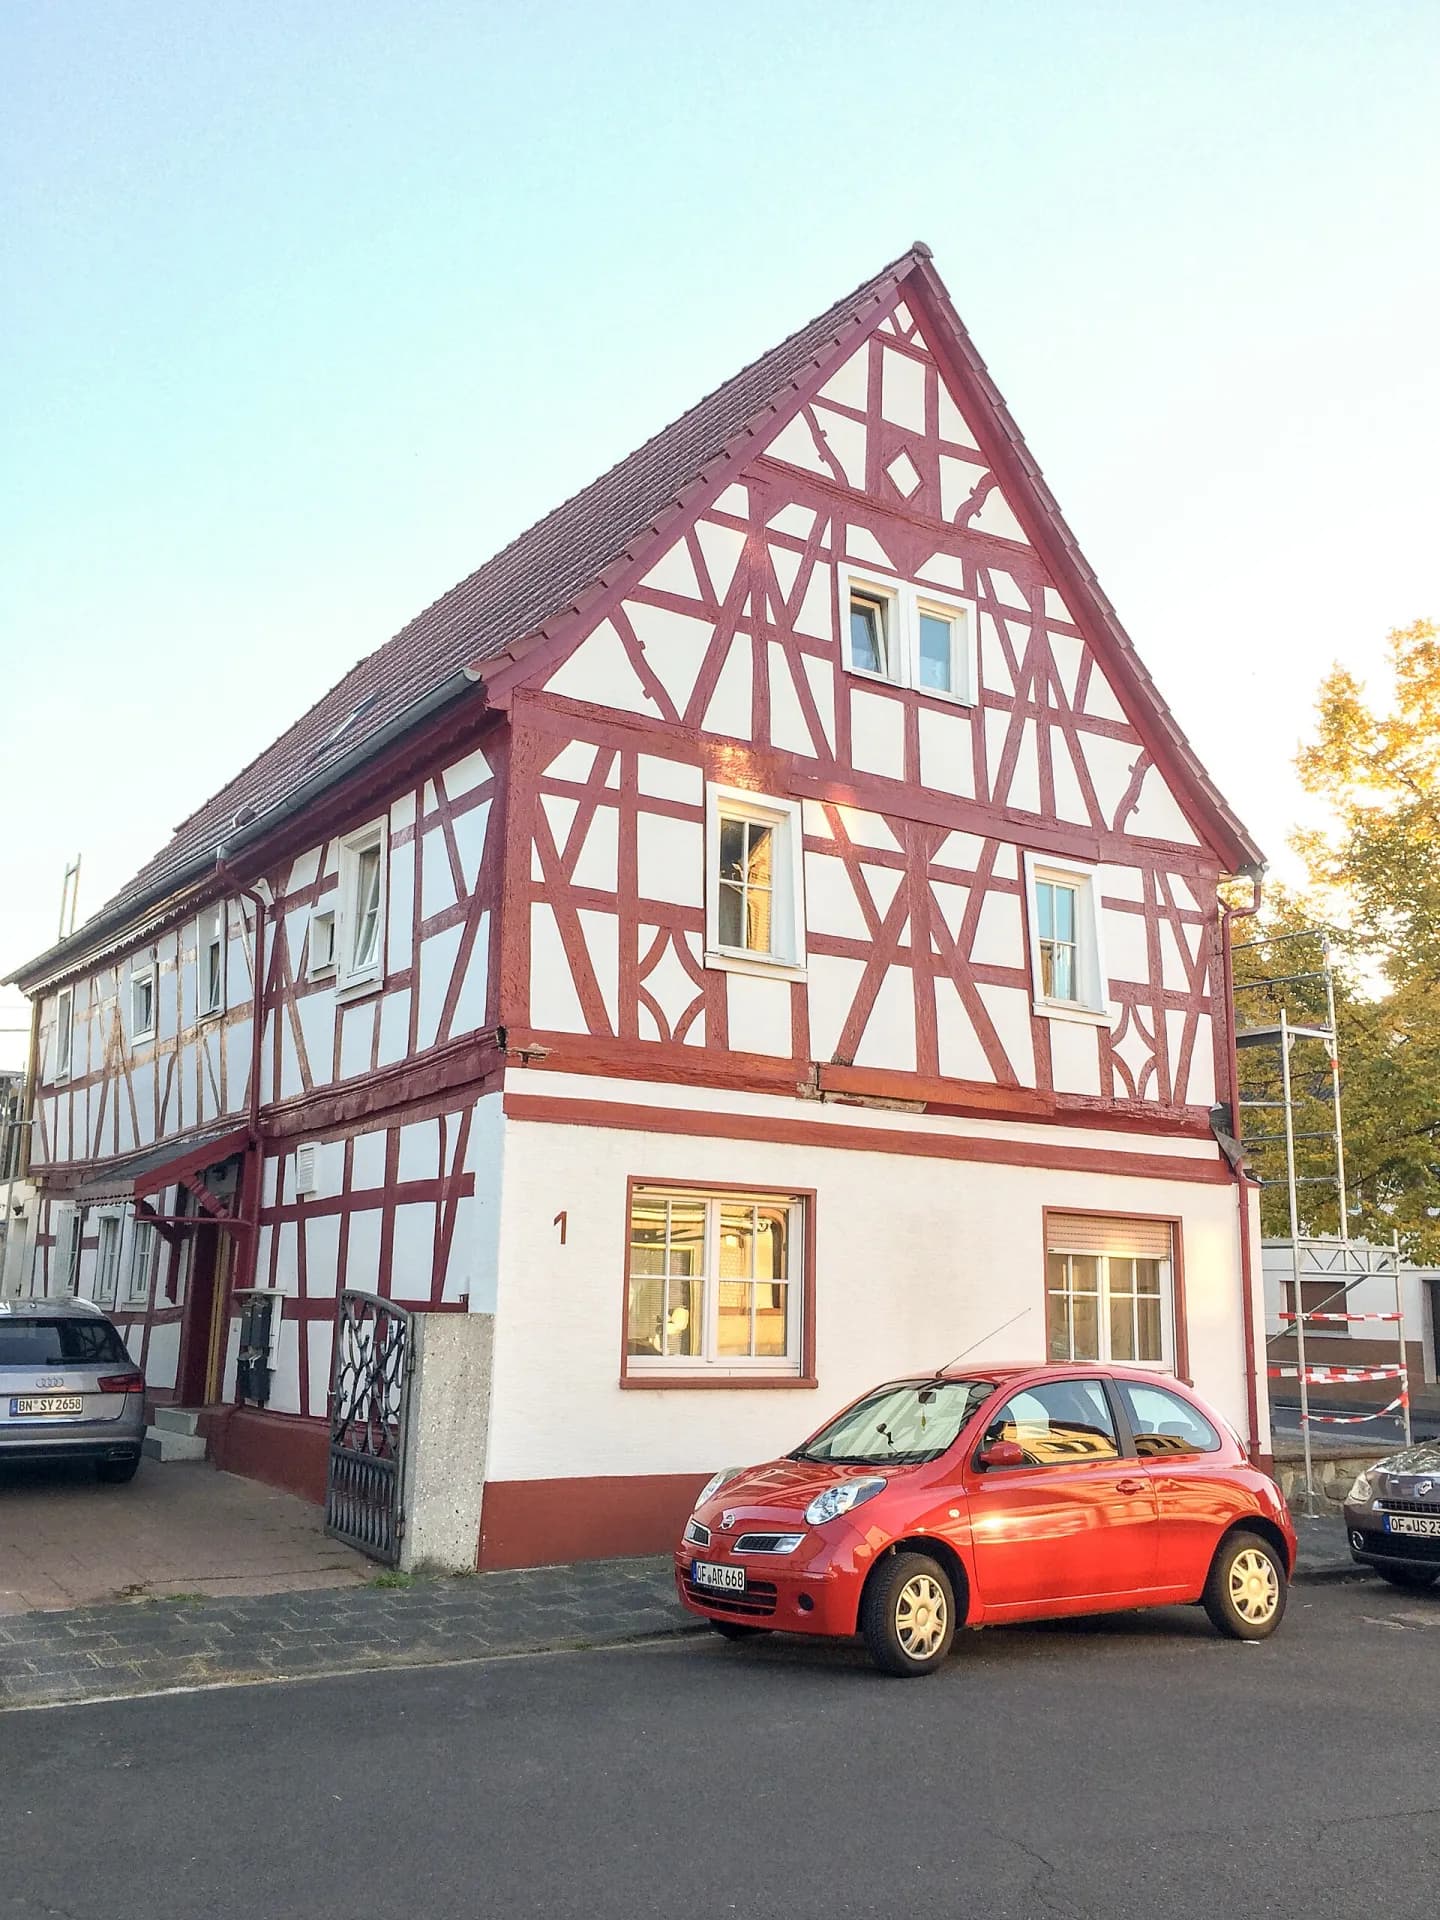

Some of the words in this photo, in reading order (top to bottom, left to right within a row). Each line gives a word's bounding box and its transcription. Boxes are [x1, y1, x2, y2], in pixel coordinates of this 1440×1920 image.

[553, 1211, 567, 1245] 1
[19, 1400, 33, 1411] BN
[40, 1399, 54, 1410] SY
[56, 1398, 81, 1410] 2658
[1391, 1518, 1404, 1530] OF
[1412, 1519, 1428, 1533] US
[712, 1567, 724, 1585] AR
[725, 1570, 743, 1588] 668
